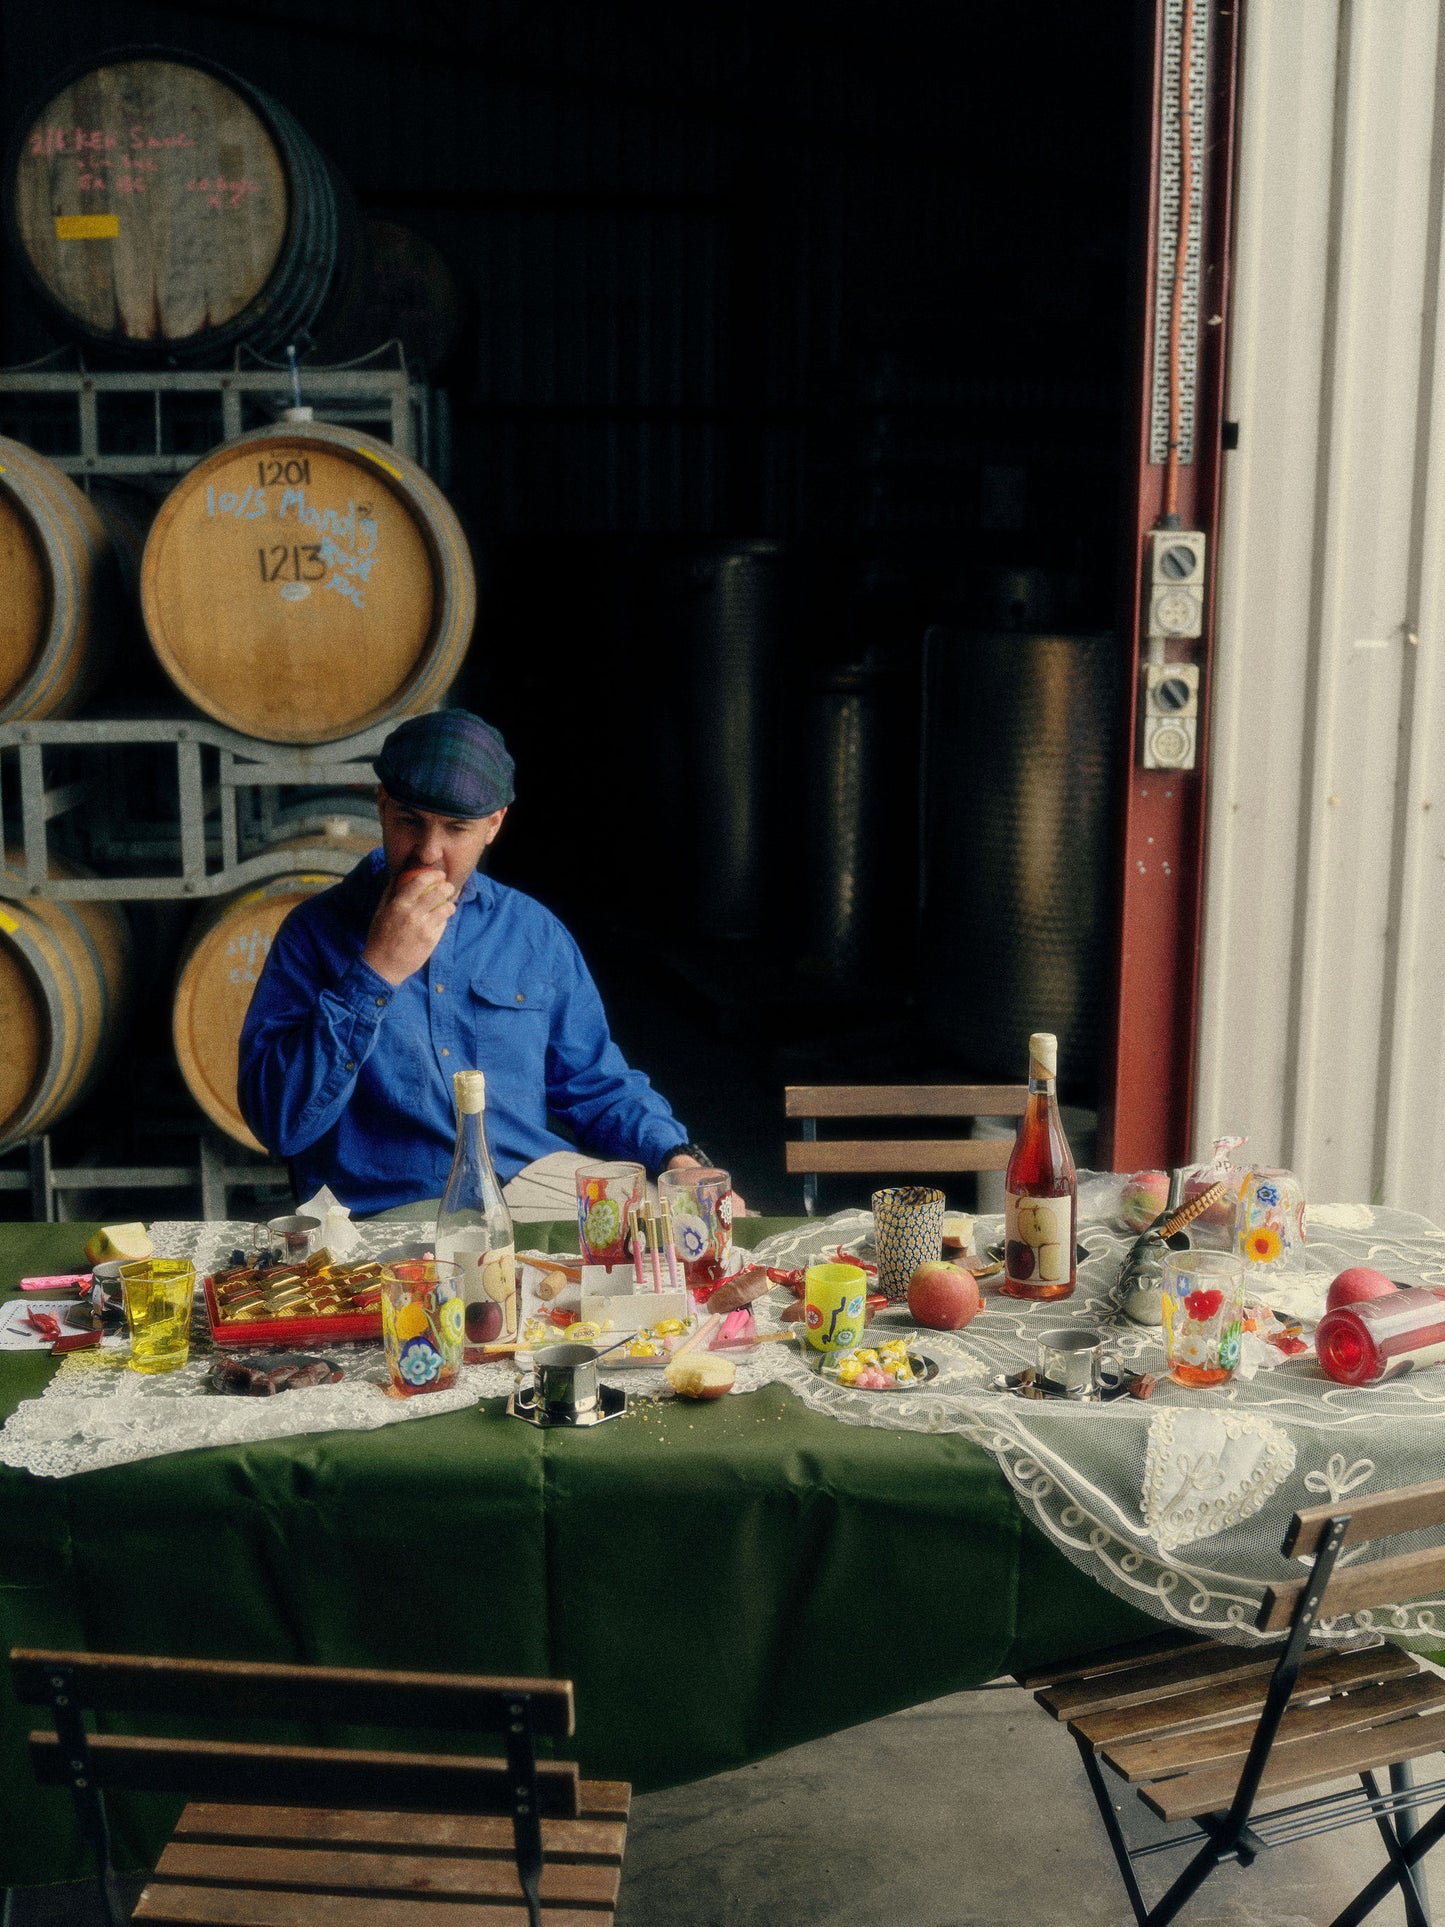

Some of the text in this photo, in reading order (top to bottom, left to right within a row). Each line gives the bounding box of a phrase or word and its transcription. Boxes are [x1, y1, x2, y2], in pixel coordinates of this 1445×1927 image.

[258, 458, 311, 487] 1201
[207, 485, 266, 519] 10/5
[258, 545, 327, 582] 1213
